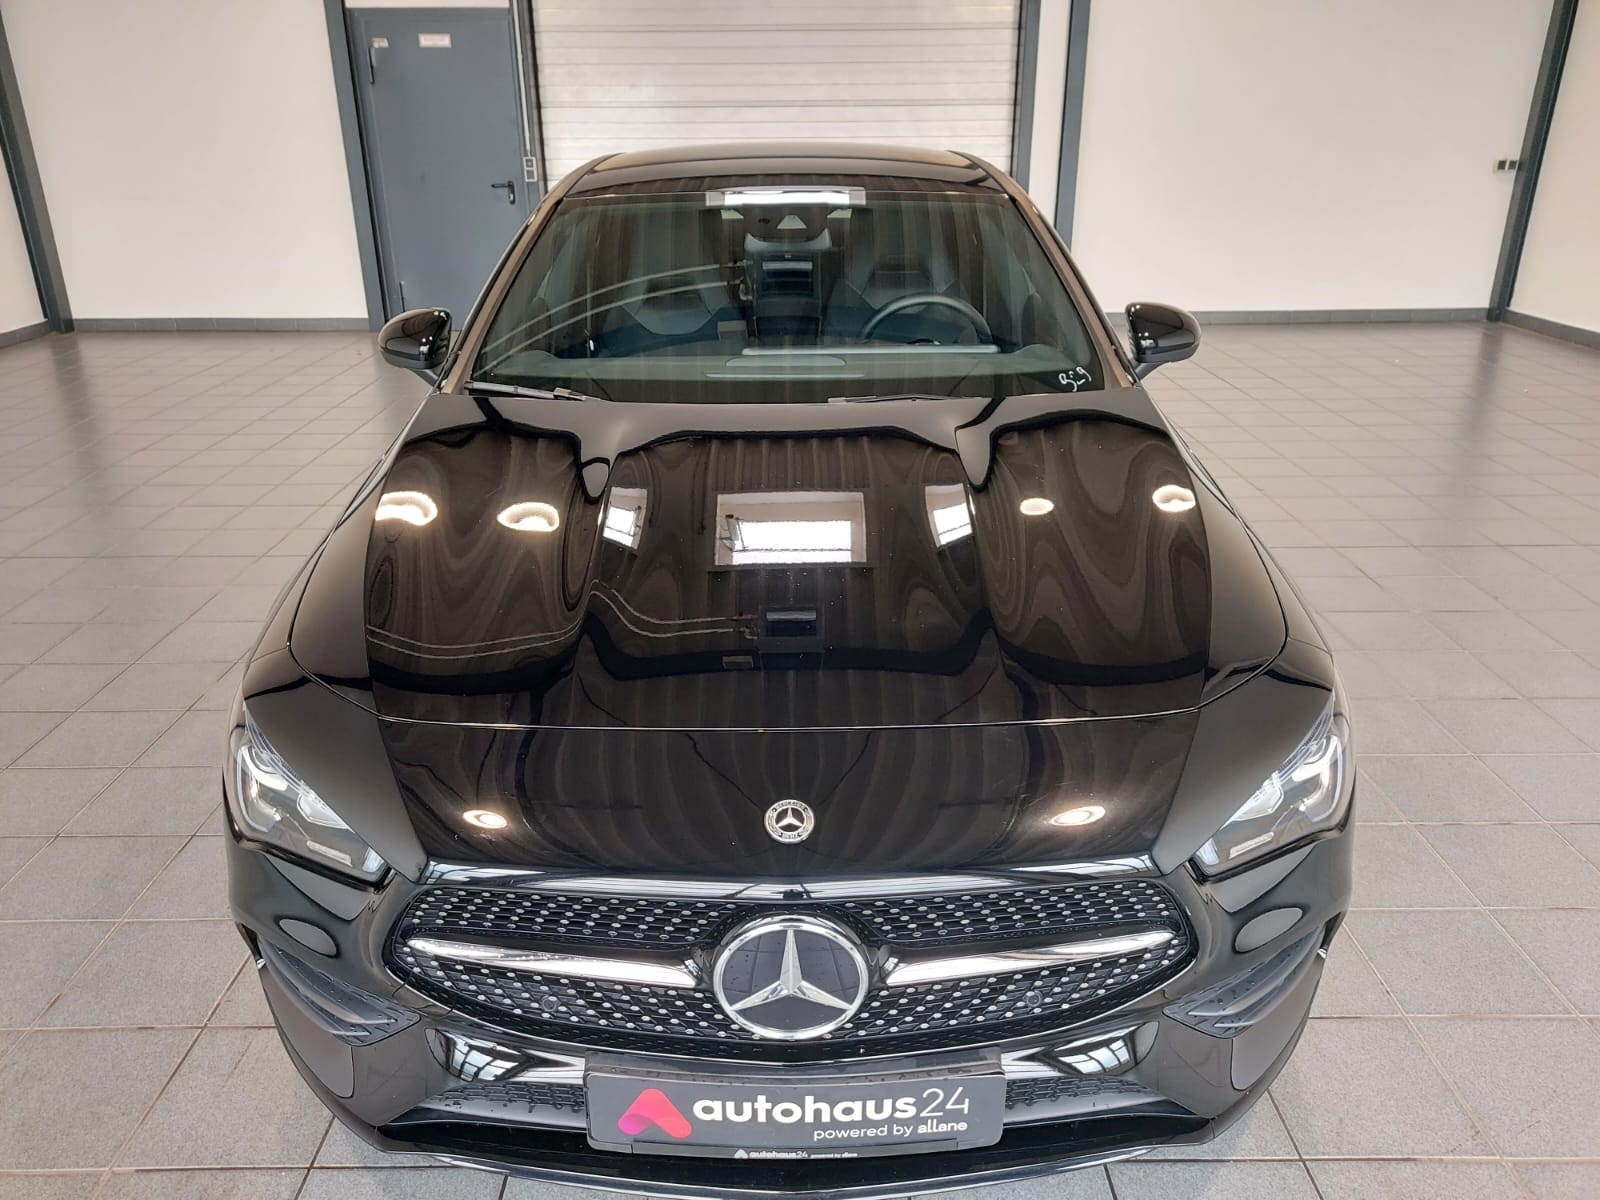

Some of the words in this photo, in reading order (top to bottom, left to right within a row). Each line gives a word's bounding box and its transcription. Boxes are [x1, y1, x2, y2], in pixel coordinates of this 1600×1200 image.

[693, 1086, 969, 1123] autohaus24
[813, 1124, 887, 1141] powered
[893, 1122, 914, 1137] by
[917, 1119, 968, 1134] allane
